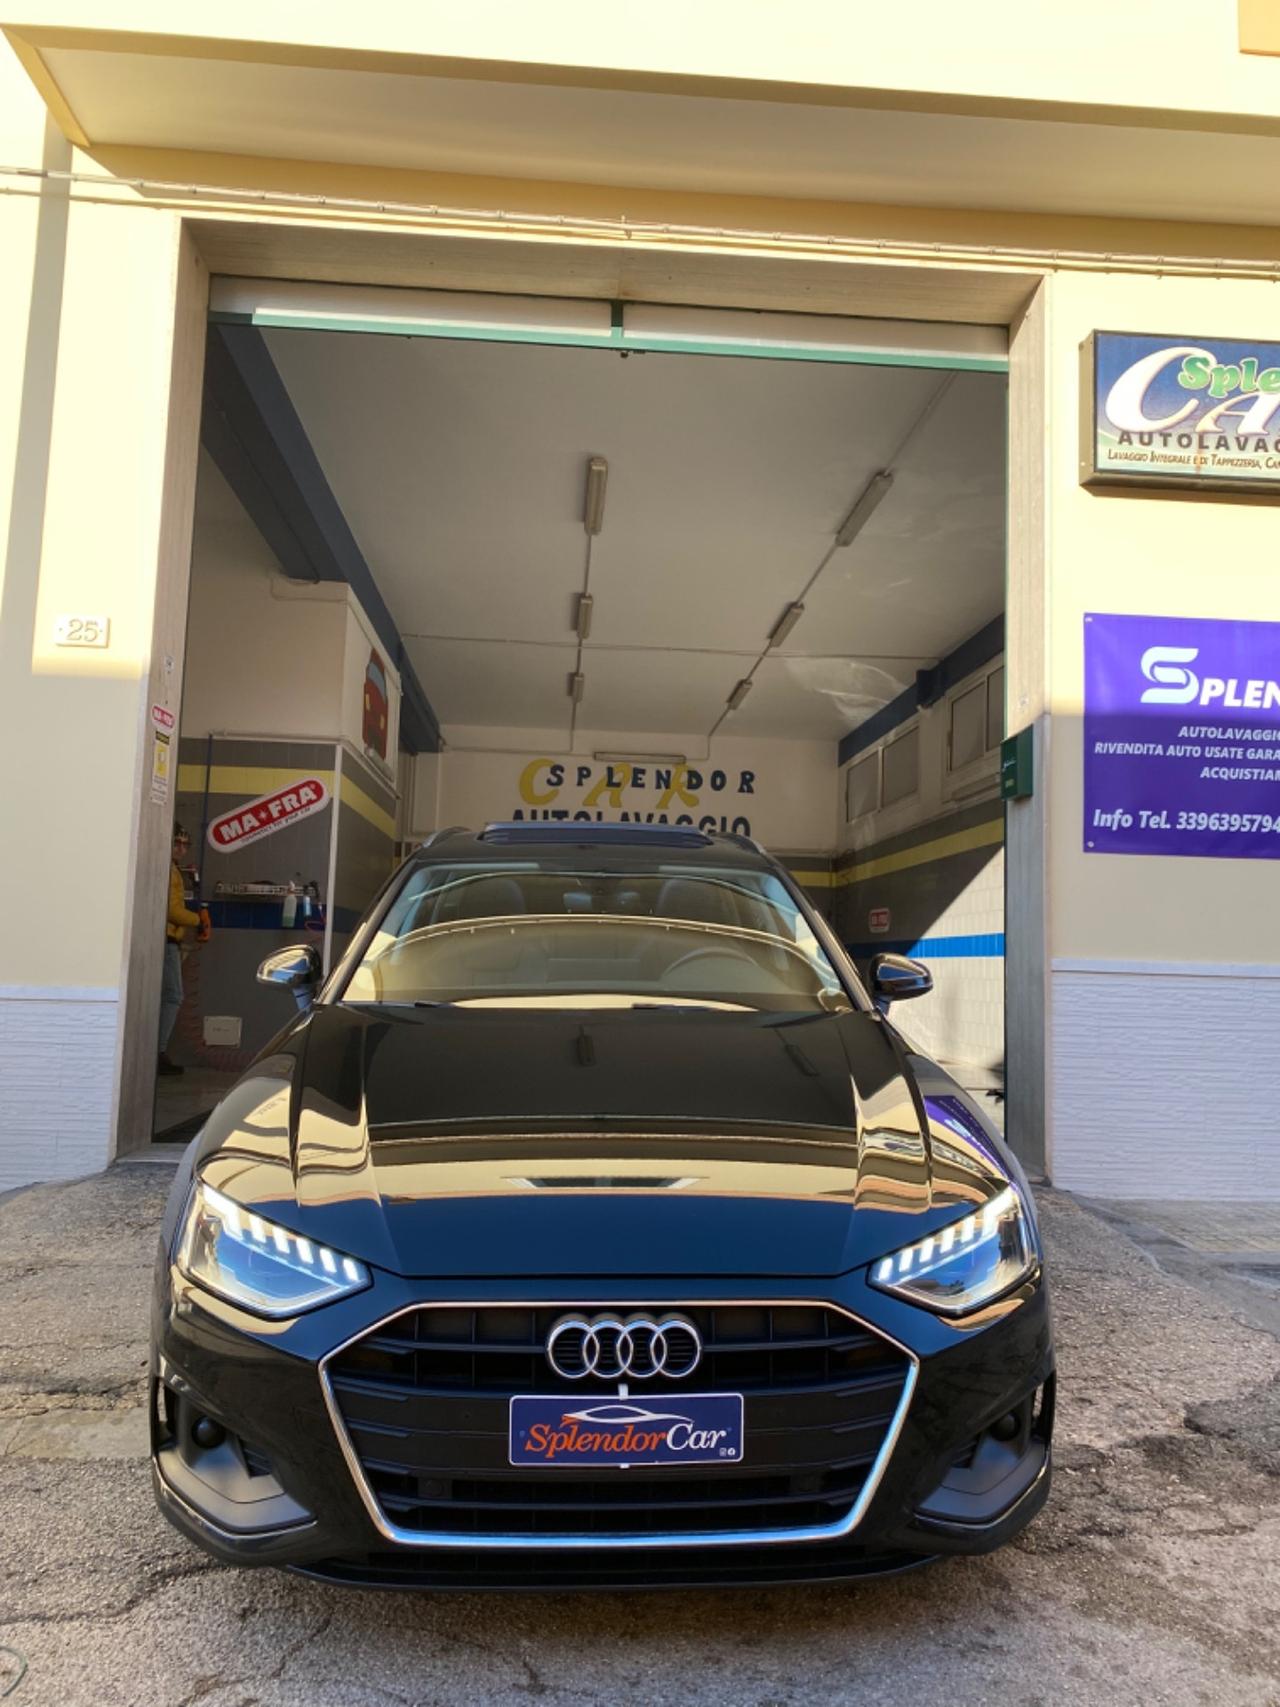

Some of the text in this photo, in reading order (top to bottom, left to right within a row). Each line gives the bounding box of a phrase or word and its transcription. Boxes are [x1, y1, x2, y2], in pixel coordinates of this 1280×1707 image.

[66, 618, 99, 642] 25
[1094, 741, 1164, 756] RIVENDITA
[1166, 745, 1202, 758] AUTO
[1204, 747, 1244, 760] USATE
[546, 763, 756, 794] SPLENDOR
[1092, 809, 1133, 831] Info
[1138, 810, 1171, 829] Tel.
